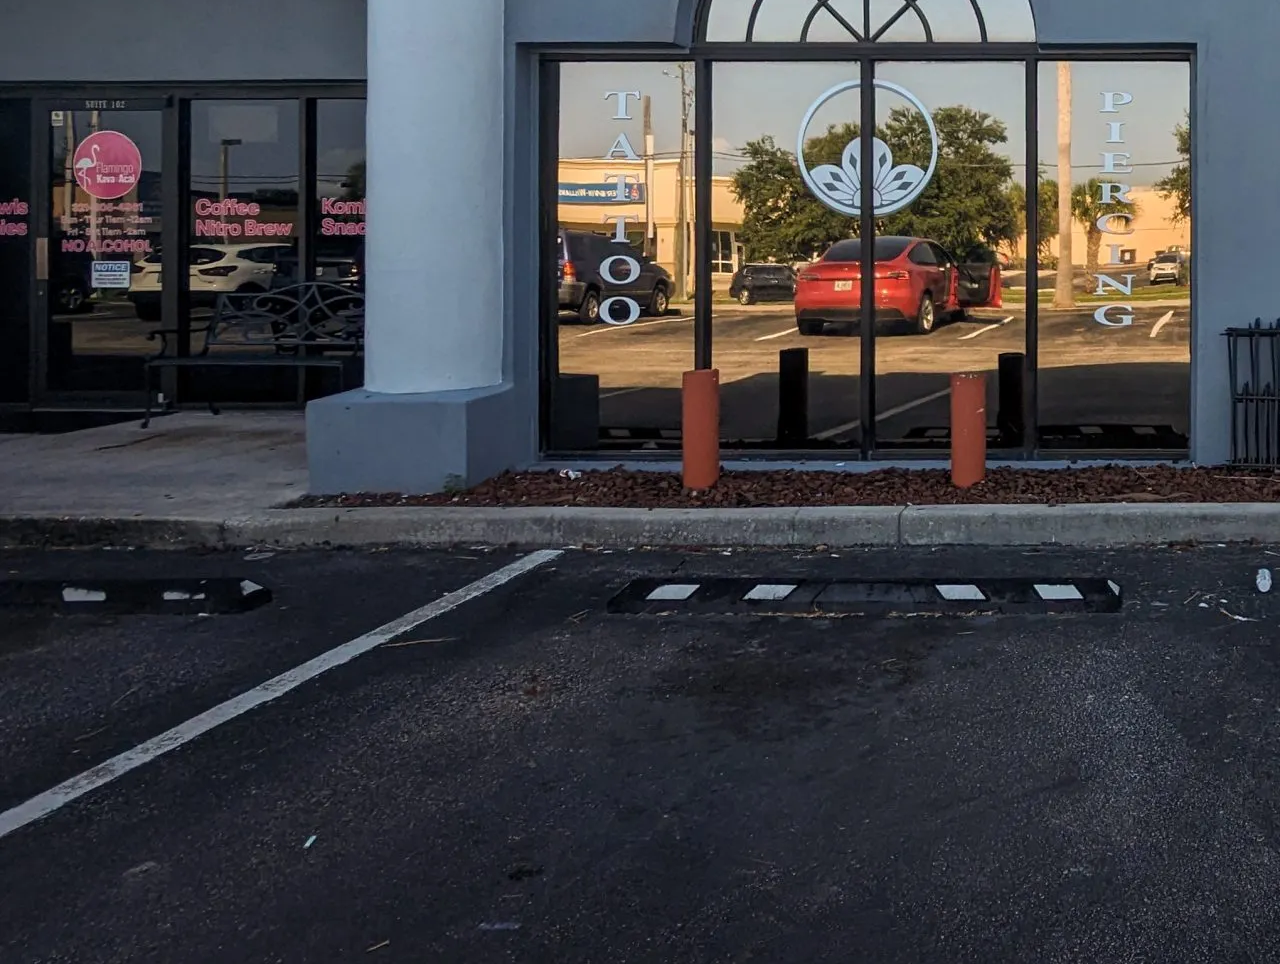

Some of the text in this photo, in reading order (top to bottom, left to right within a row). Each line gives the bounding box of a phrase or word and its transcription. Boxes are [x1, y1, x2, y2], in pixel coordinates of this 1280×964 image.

[85, 100, 107, 109] SUITE
[96, 162, 134, 175] Flamingo
[195, 198, 260, 216] Coffee
[600, 89, 641, 327] TATTOO
[1094, 90, 1136, 329] PIERCING
[195, 220, 293, 237] Nitro Brew
[61, 239, 153, 253] NO ALCOHOL
[94, 263, 127, 272] NOTICE
